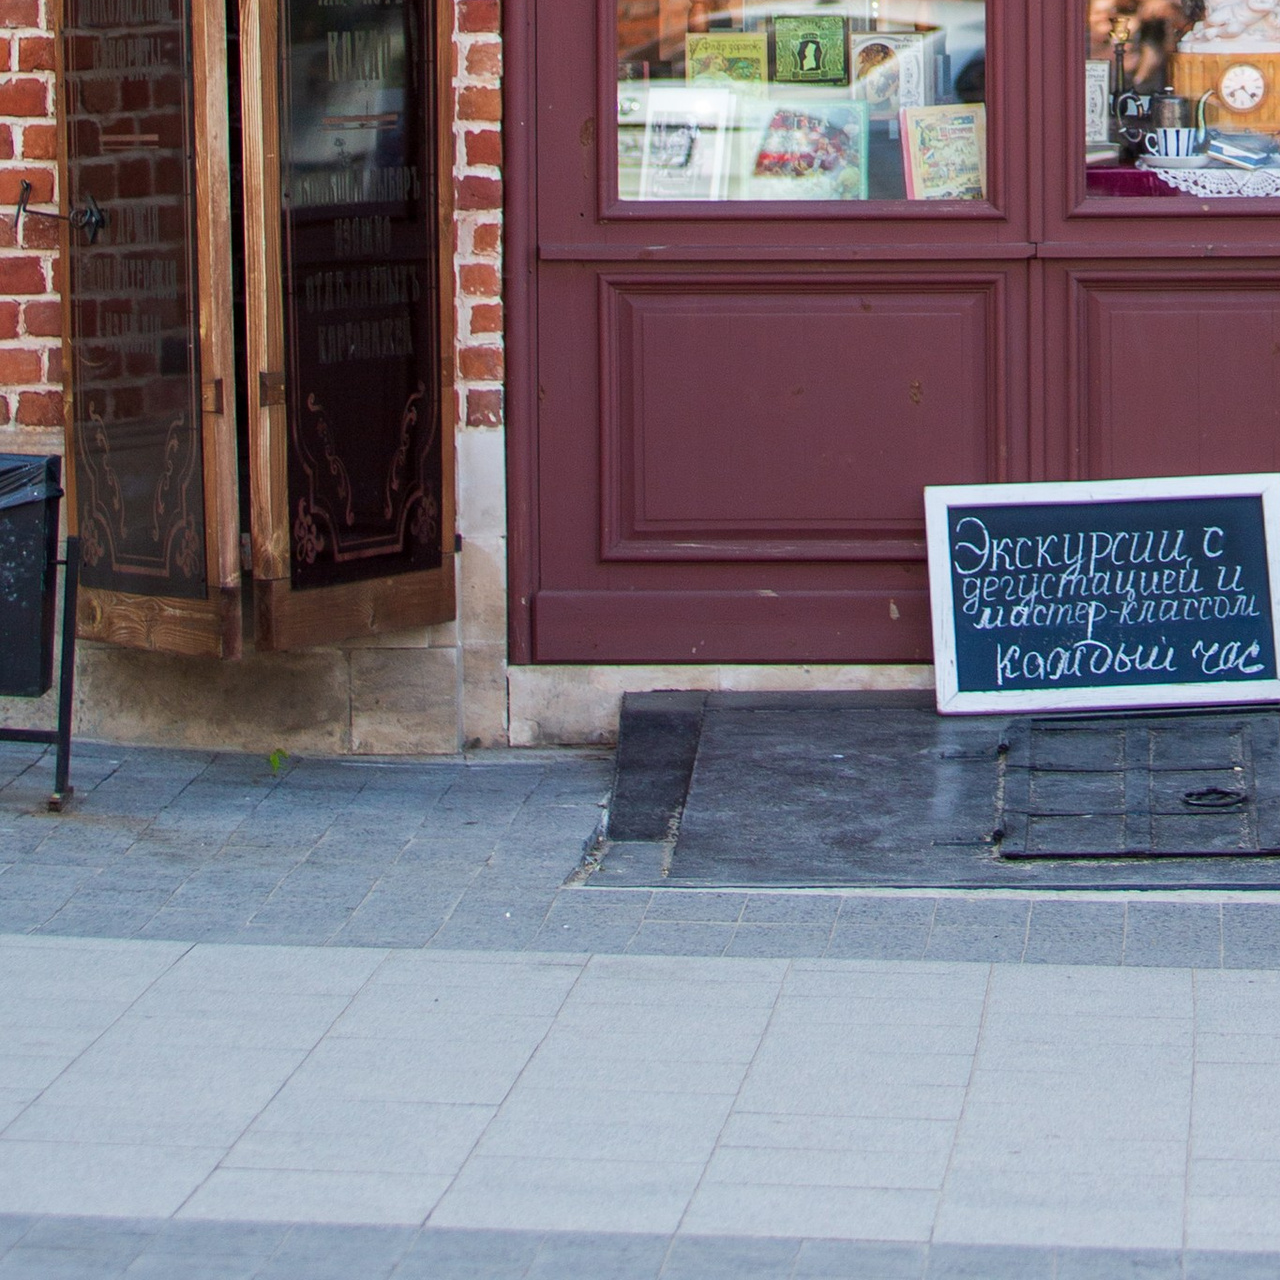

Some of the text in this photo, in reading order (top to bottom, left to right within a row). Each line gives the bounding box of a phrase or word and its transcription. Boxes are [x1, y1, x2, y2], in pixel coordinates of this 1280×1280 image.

[954, 516, 1225, 578] Экскурсии с
[962, 558, 1245, 615] дегустацией и
[973, 593, 1261, 640] мастер-классом
[1191, 639, 1266, 676] час
